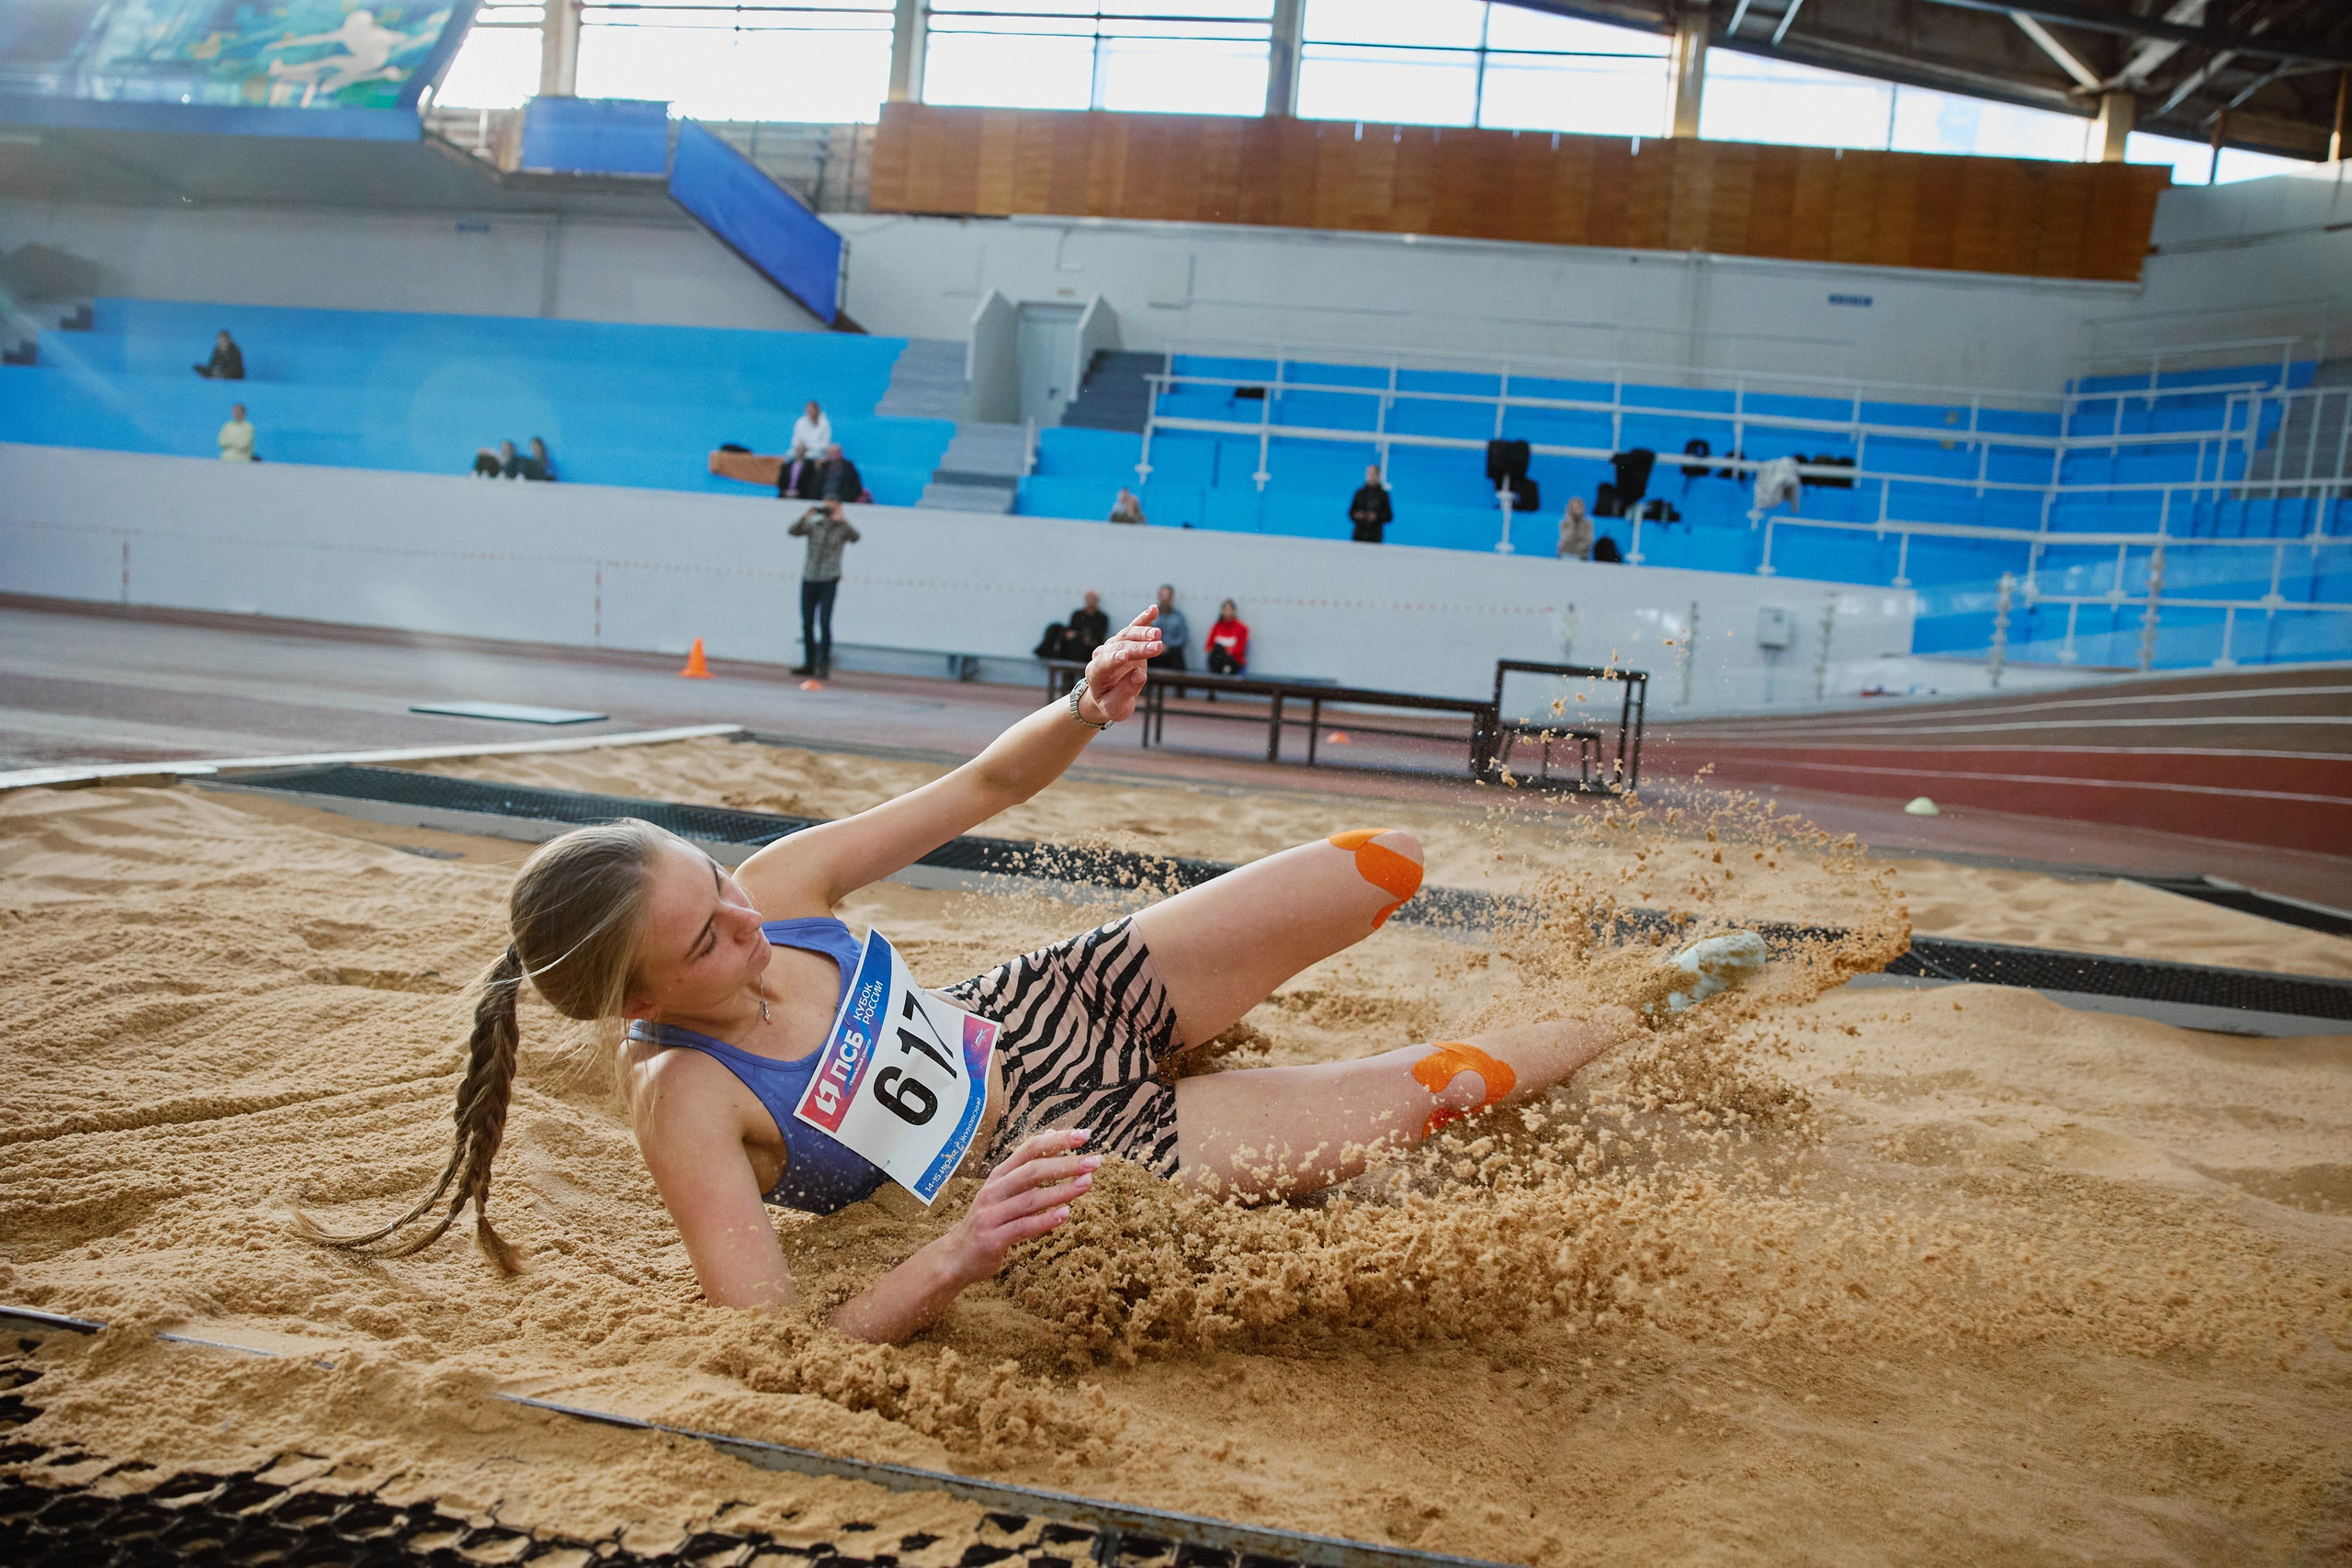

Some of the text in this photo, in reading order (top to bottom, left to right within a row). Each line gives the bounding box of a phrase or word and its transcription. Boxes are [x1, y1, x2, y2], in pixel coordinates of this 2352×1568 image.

[853, 982, 874, 1021] КУБОК
[862, 980, 884, 1025] РОССИИ
[830, 1028, 865, 1082] ПСБ
[873, 989, 957, 1126] 617
[925, 1173, 942, 1192] 14-15
